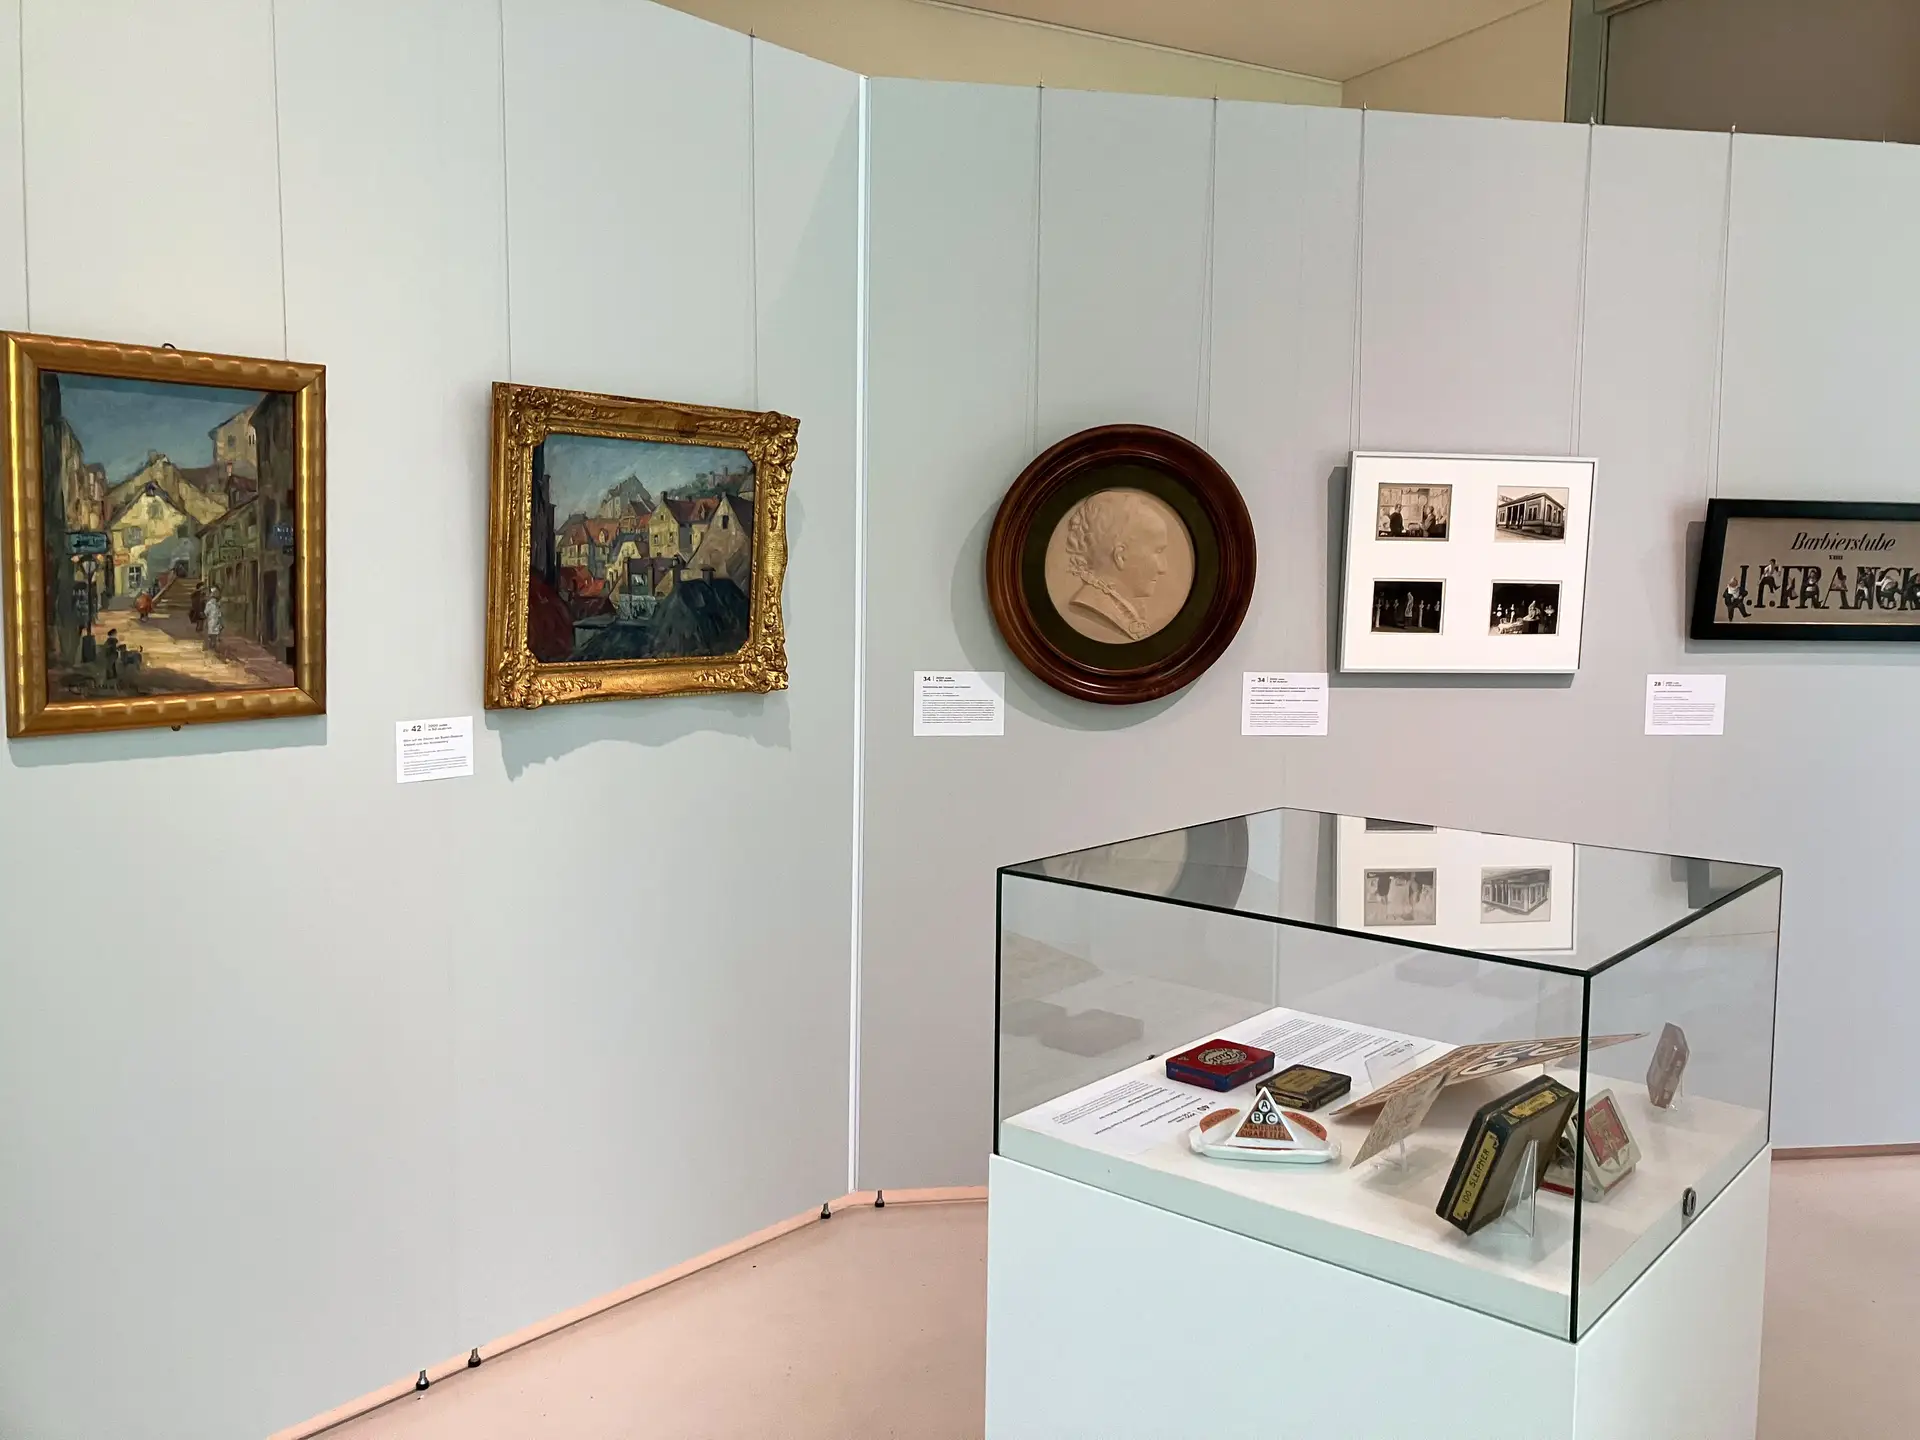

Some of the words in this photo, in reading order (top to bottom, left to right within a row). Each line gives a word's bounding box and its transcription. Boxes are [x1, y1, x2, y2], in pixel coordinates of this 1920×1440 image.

[1790, 532, 1896, 551] Barbierstube
[1261, 1100, 1269, 1110] A
[1254, 1112, 1261, 1121] B
[1267, 1114, 1276, 1123] C
[1469, 1149, 1490, 1188] SLEIPNER
